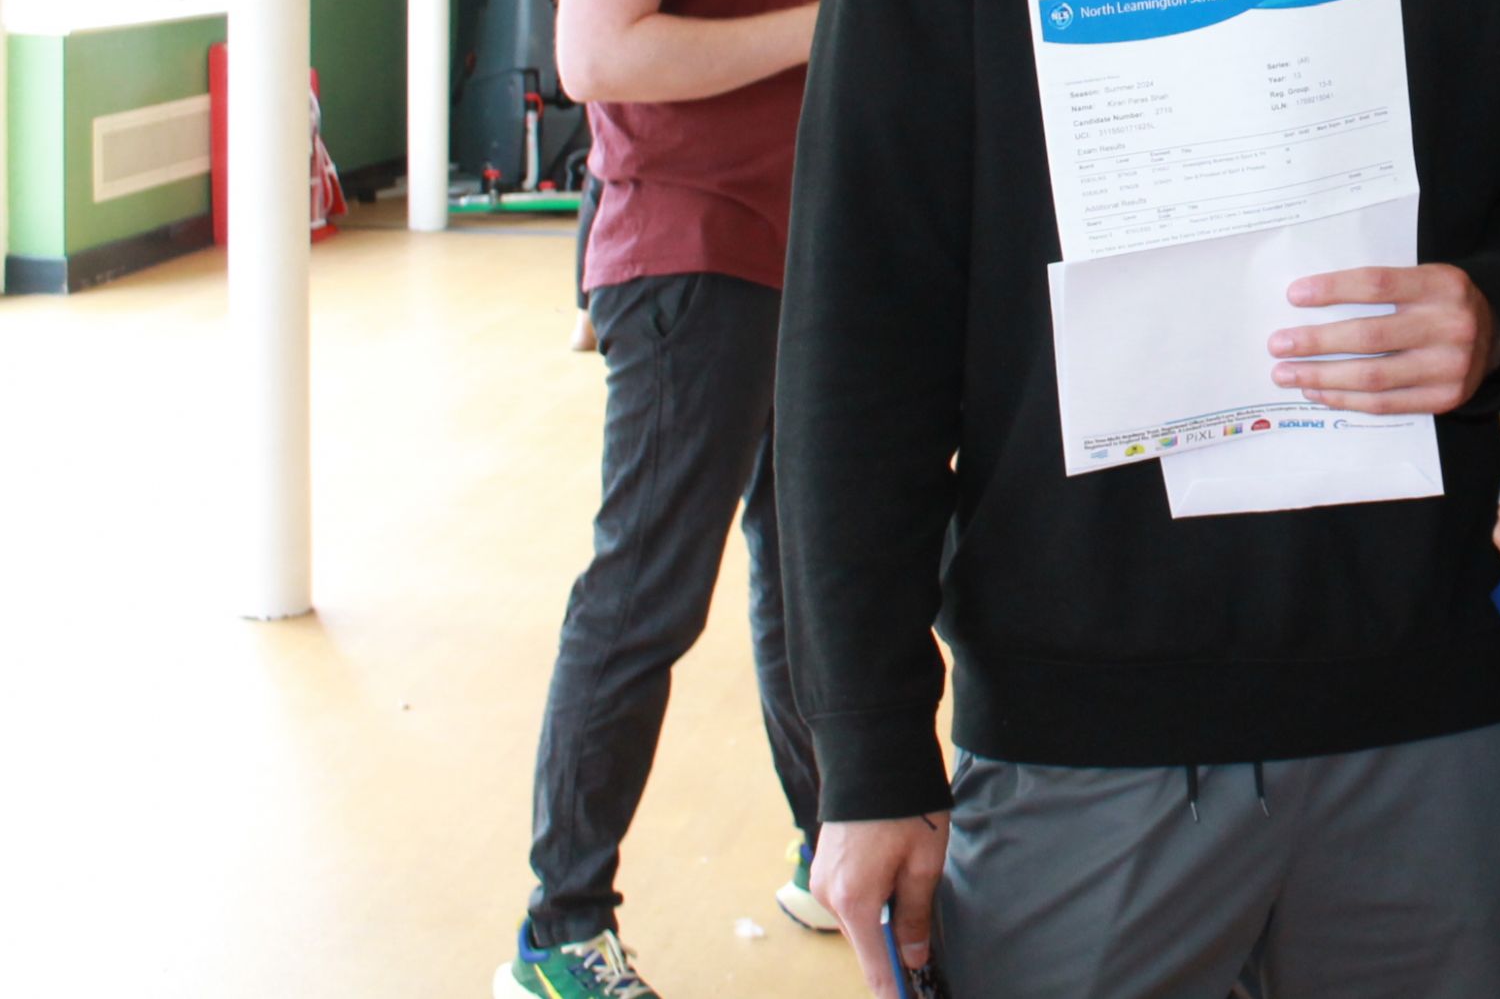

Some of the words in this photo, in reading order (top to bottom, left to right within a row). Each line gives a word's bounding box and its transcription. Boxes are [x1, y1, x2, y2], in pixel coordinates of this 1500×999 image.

[1080, 4, 1115, 18] North
[1072, 115, 1111, 128] Candidate
[1077, 147, 1098, 156] Exam
[1099, 142, 1126, 152] Results
[1278, 418, 1325, 429] sound
[1185, 429, 1217, 444] PiXL
